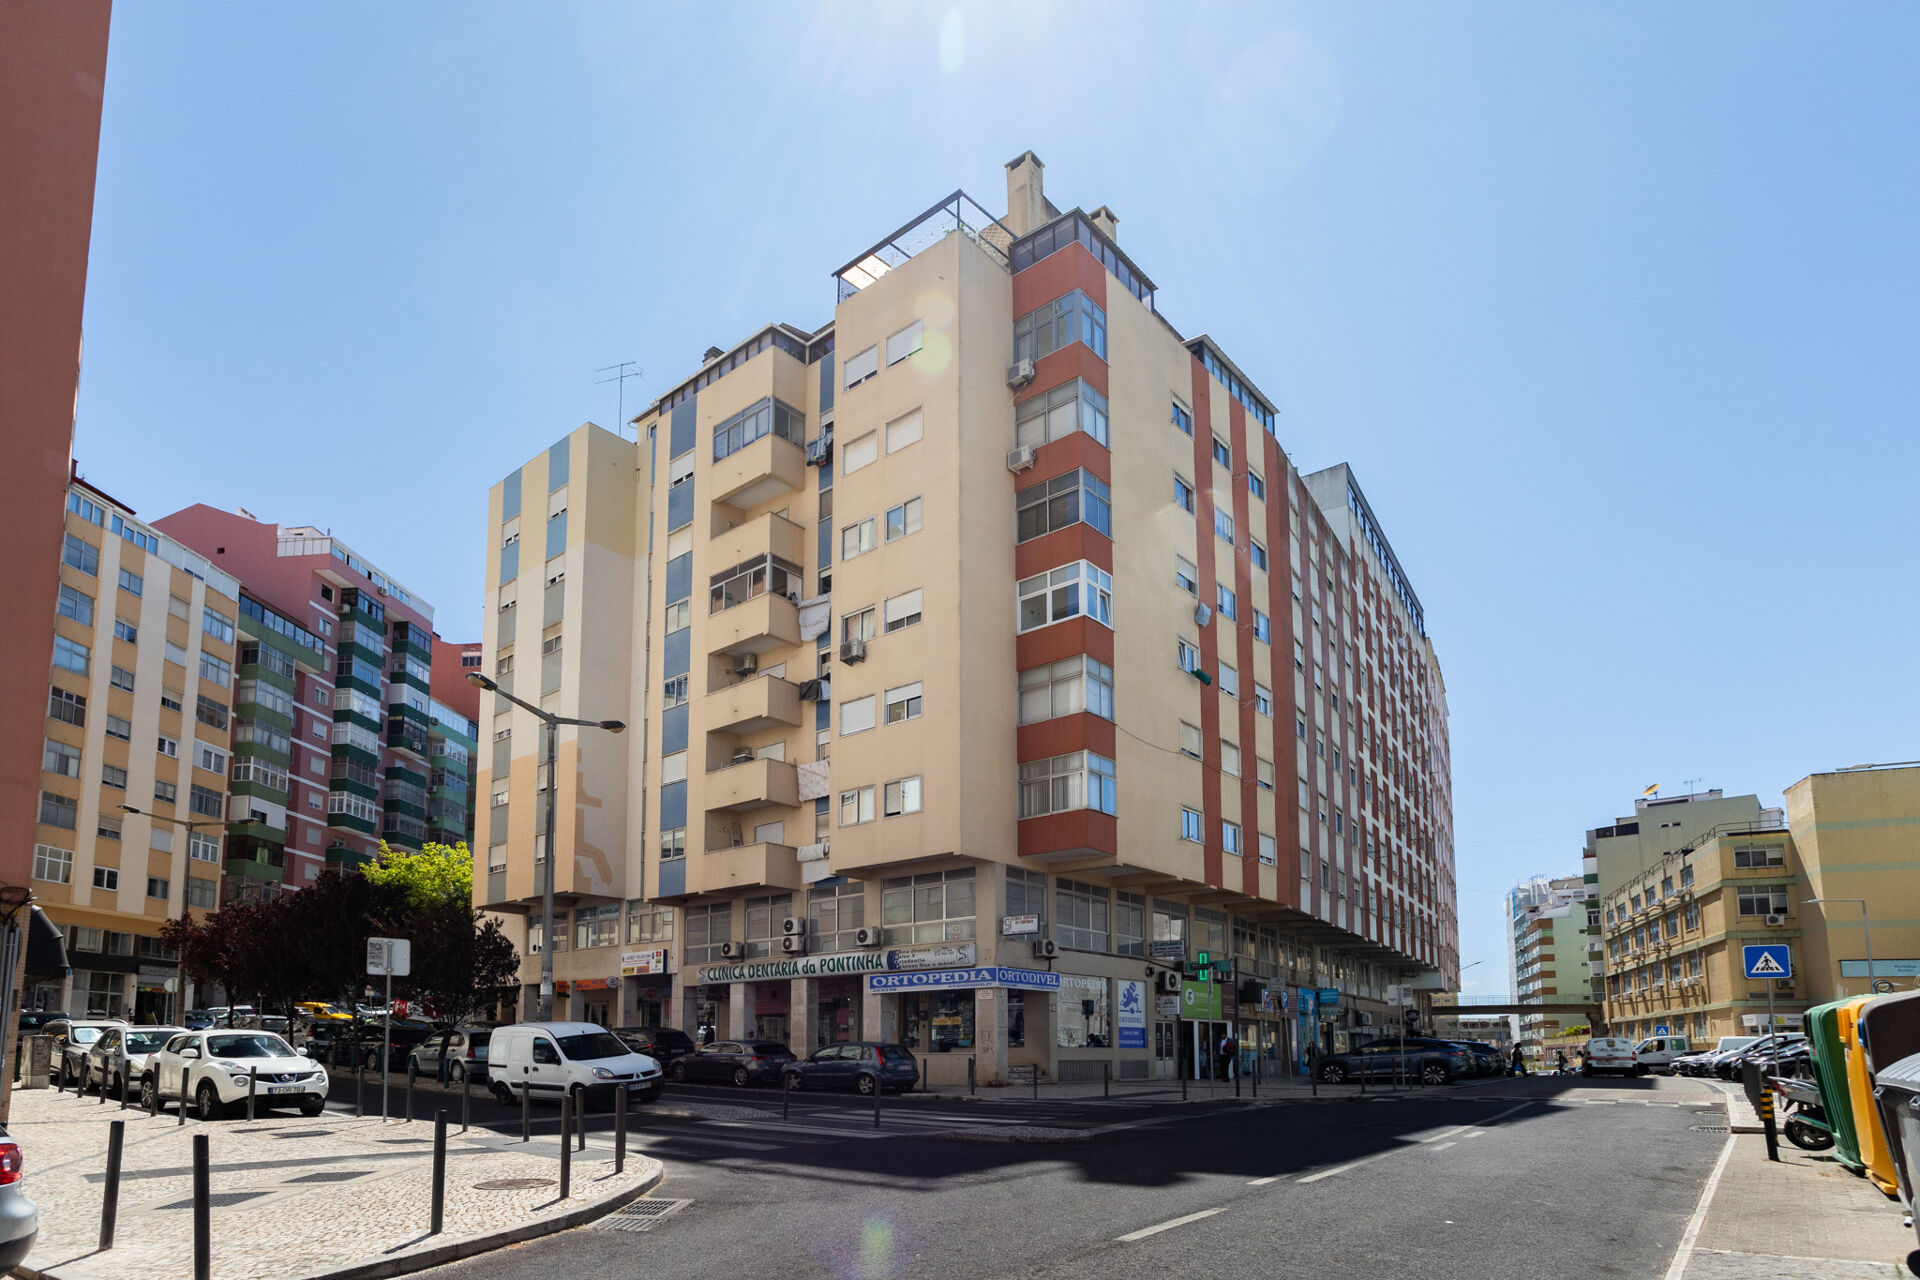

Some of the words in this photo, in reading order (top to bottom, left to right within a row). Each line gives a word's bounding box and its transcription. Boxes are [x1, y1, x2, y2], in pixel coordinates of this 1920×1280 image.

[802, 959, 817, 975] da
[820, 954, 884, 973] PONTINHA
[872, 970, 992, 987] ORTOPEDIA
[1000, 970, 1059, 985] ORTODIVEL
